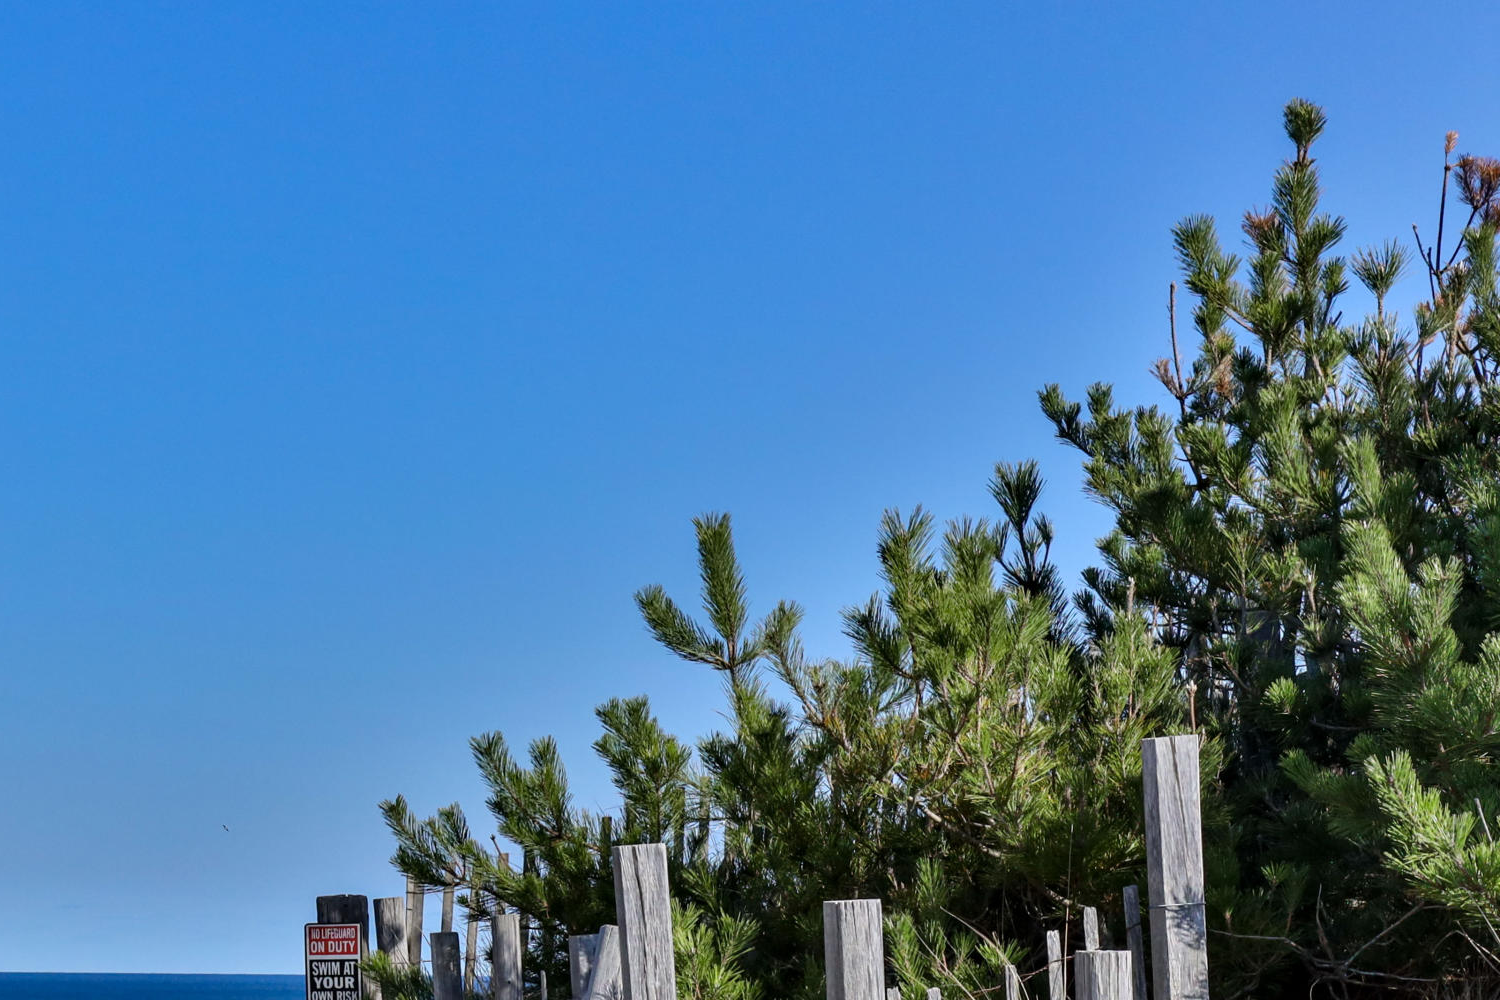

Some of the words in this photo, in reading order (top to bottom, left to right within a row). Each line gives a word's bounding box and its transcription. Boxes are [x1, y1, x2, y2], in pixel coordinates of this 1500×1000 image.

[312, 928, 320, 939] NO
[322, 928, 355, 939] LIFEGUARD
[310, 941, 324, 952] ON
[328, 941, 355, 952] DUTY
[312, 962, 340, 976] SWIM
[344, 961, 355, 976] AT
[314, 977, 354, 989] YOUR
